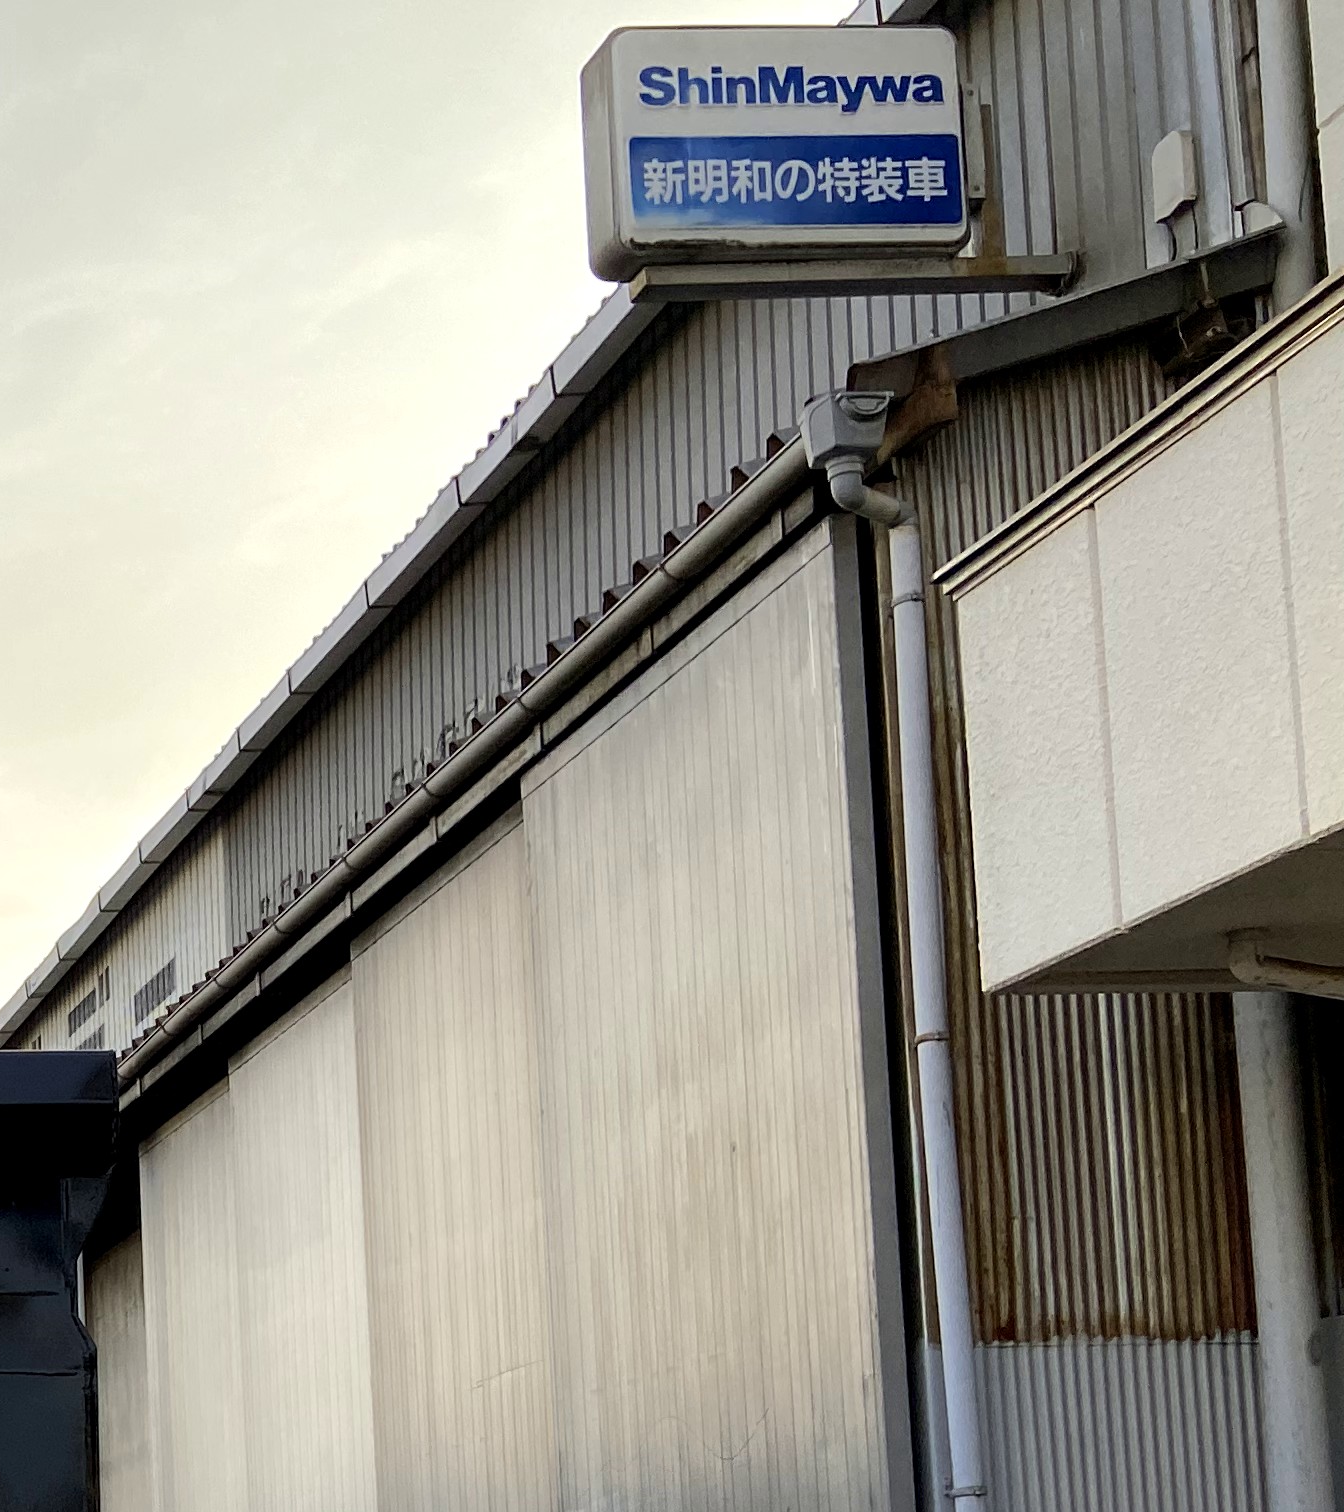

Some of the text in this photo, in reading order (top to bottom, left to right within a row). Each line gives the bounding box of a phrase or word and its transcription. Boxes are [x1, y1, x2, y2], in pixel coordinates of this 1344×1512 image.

[639, 66, 944, 113] ShinMaywa
[643, 156, 949, 206] 新明和の特装車
